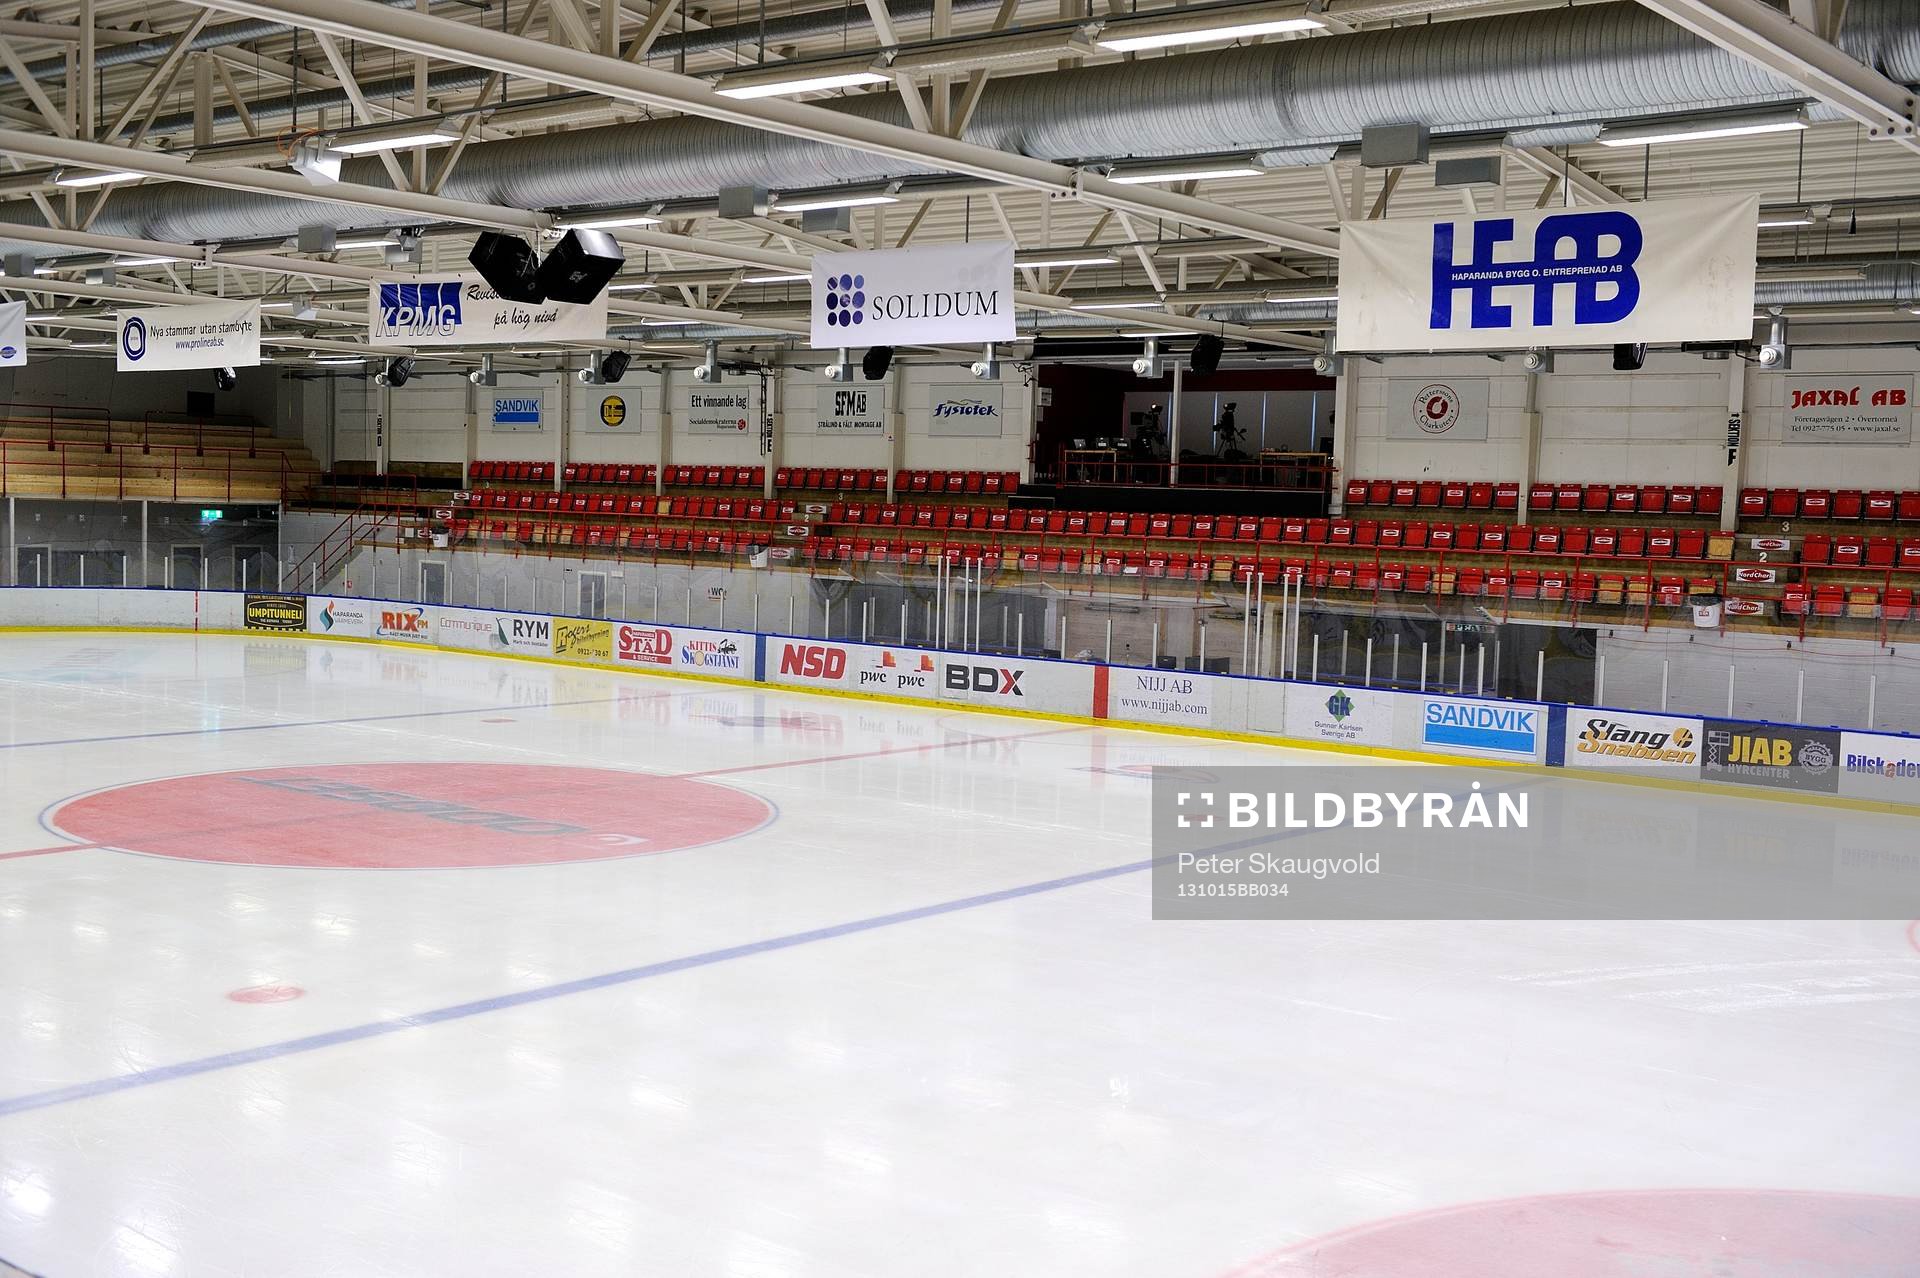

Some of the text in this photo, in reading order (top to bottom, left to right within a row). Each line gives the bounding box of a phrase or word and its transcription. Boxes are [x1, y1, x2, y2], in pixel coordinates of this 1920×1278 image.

[1451, 264, 1623, 281] HAPARANDA BYGG O. ENTREPRENAD AB
[872, 290, 999, 321] SOLIDUM
[376, 304, 456, 337] KPMG
[493, 307, 559, 330] på hög nivå
[150, 325, 164, 339] Nya
[165, 324, 196, 336] stammar
[200, 322, 217, 335] utan
[218, 319, 253, 338] stambyte
[175, 336, 225, 351] www.prolineab.se
[495, 399, 539, 413] SANDVIK
[691, 394, 747, 410] Ett vinnande lag
[835, 391, 867, 416] SFM AB
[1871, 389, 1907, 407] AB
[1794, 415, 1843, 425] Företagsvägen
[1857, 415, 1898, 423] Övertorneå
[1802, 425, 1835, 433] 0927-775
[1853, 425, 1901, 433] www.jaxal.se
[1727, 419, 1741, 447] SEKTION
[1781, 521, 1790, 532] 3
[1759, 552, 1768, 563] 2
[249, 607, 302, 620] UMPITUNNELI
[381, 611, 428, 632] RIX FM
[513, 619, 549, 640] RYM
[618, 625, 673, 655] STÄD
[689, 640, 717, 652] KITTIS
[780, 644, 847, 680] NSD
[860, 670, 925, 688] pwc pwc
[945, 663, 1024, 697] BDX
[1136, 675, 1193, 694] NIJJ AB
[1121, 697, 1208, 715] www.nijjab.com
[1328, 694, 1351, 717] GK
[1314, 720, 1337, 731] Gunnar
[1426, 703, 1534, 733] SANDVIK
[1321, 729, 1345, 739] Sverige
[1727, 735, 1793, 767] JIAB
[1727, 763, 1790, 780] HYRCENTER
